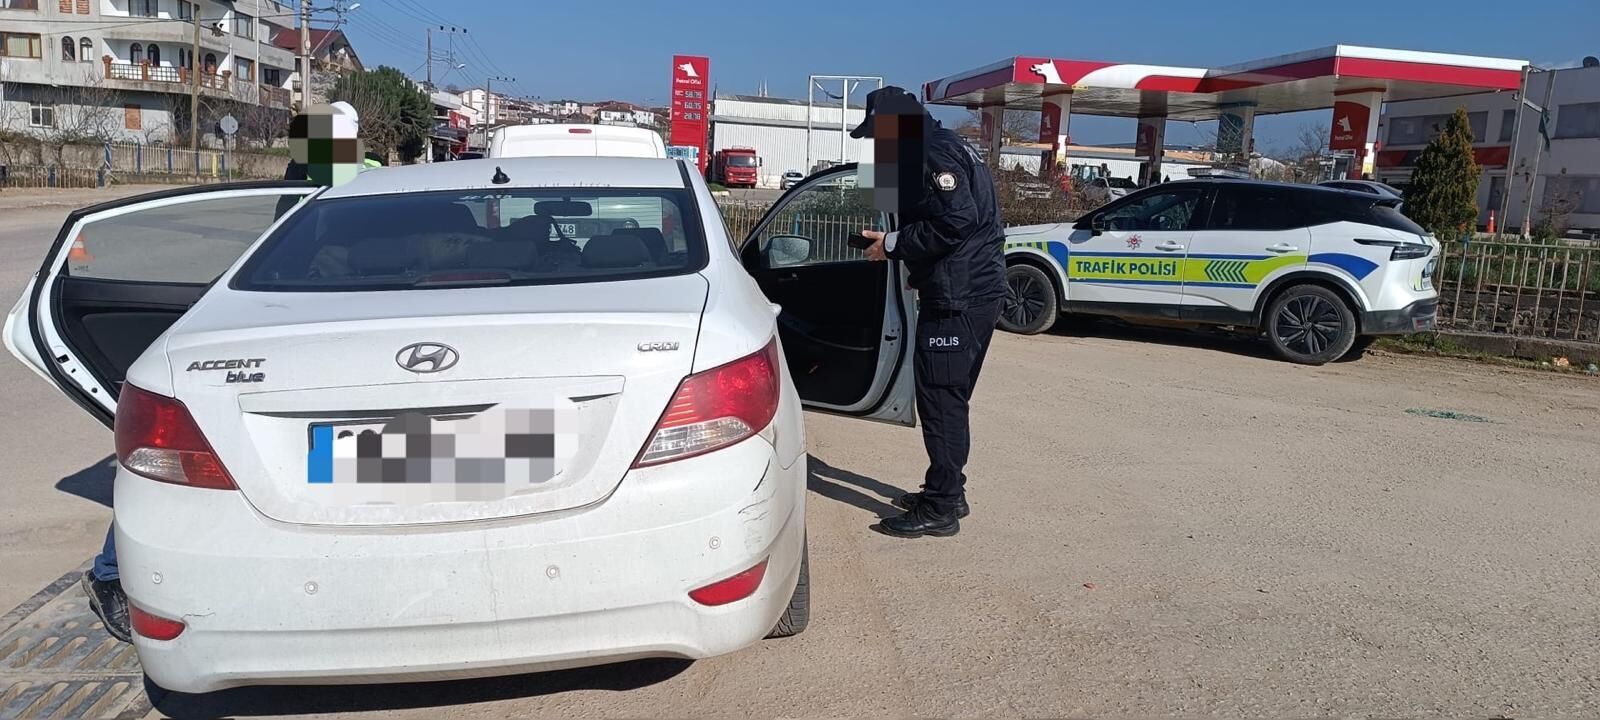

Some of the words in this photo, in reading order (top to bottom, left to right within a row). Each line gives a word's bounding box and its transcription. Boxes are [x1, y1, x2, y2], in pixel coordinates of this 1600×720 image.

[1076, 260, 1126, 274] TRAFİK
[1129, 261, 1177, 276] POLİSİ
[186, 358, 266, 371] ACCENT
[225, 370, 265, 383] blue
